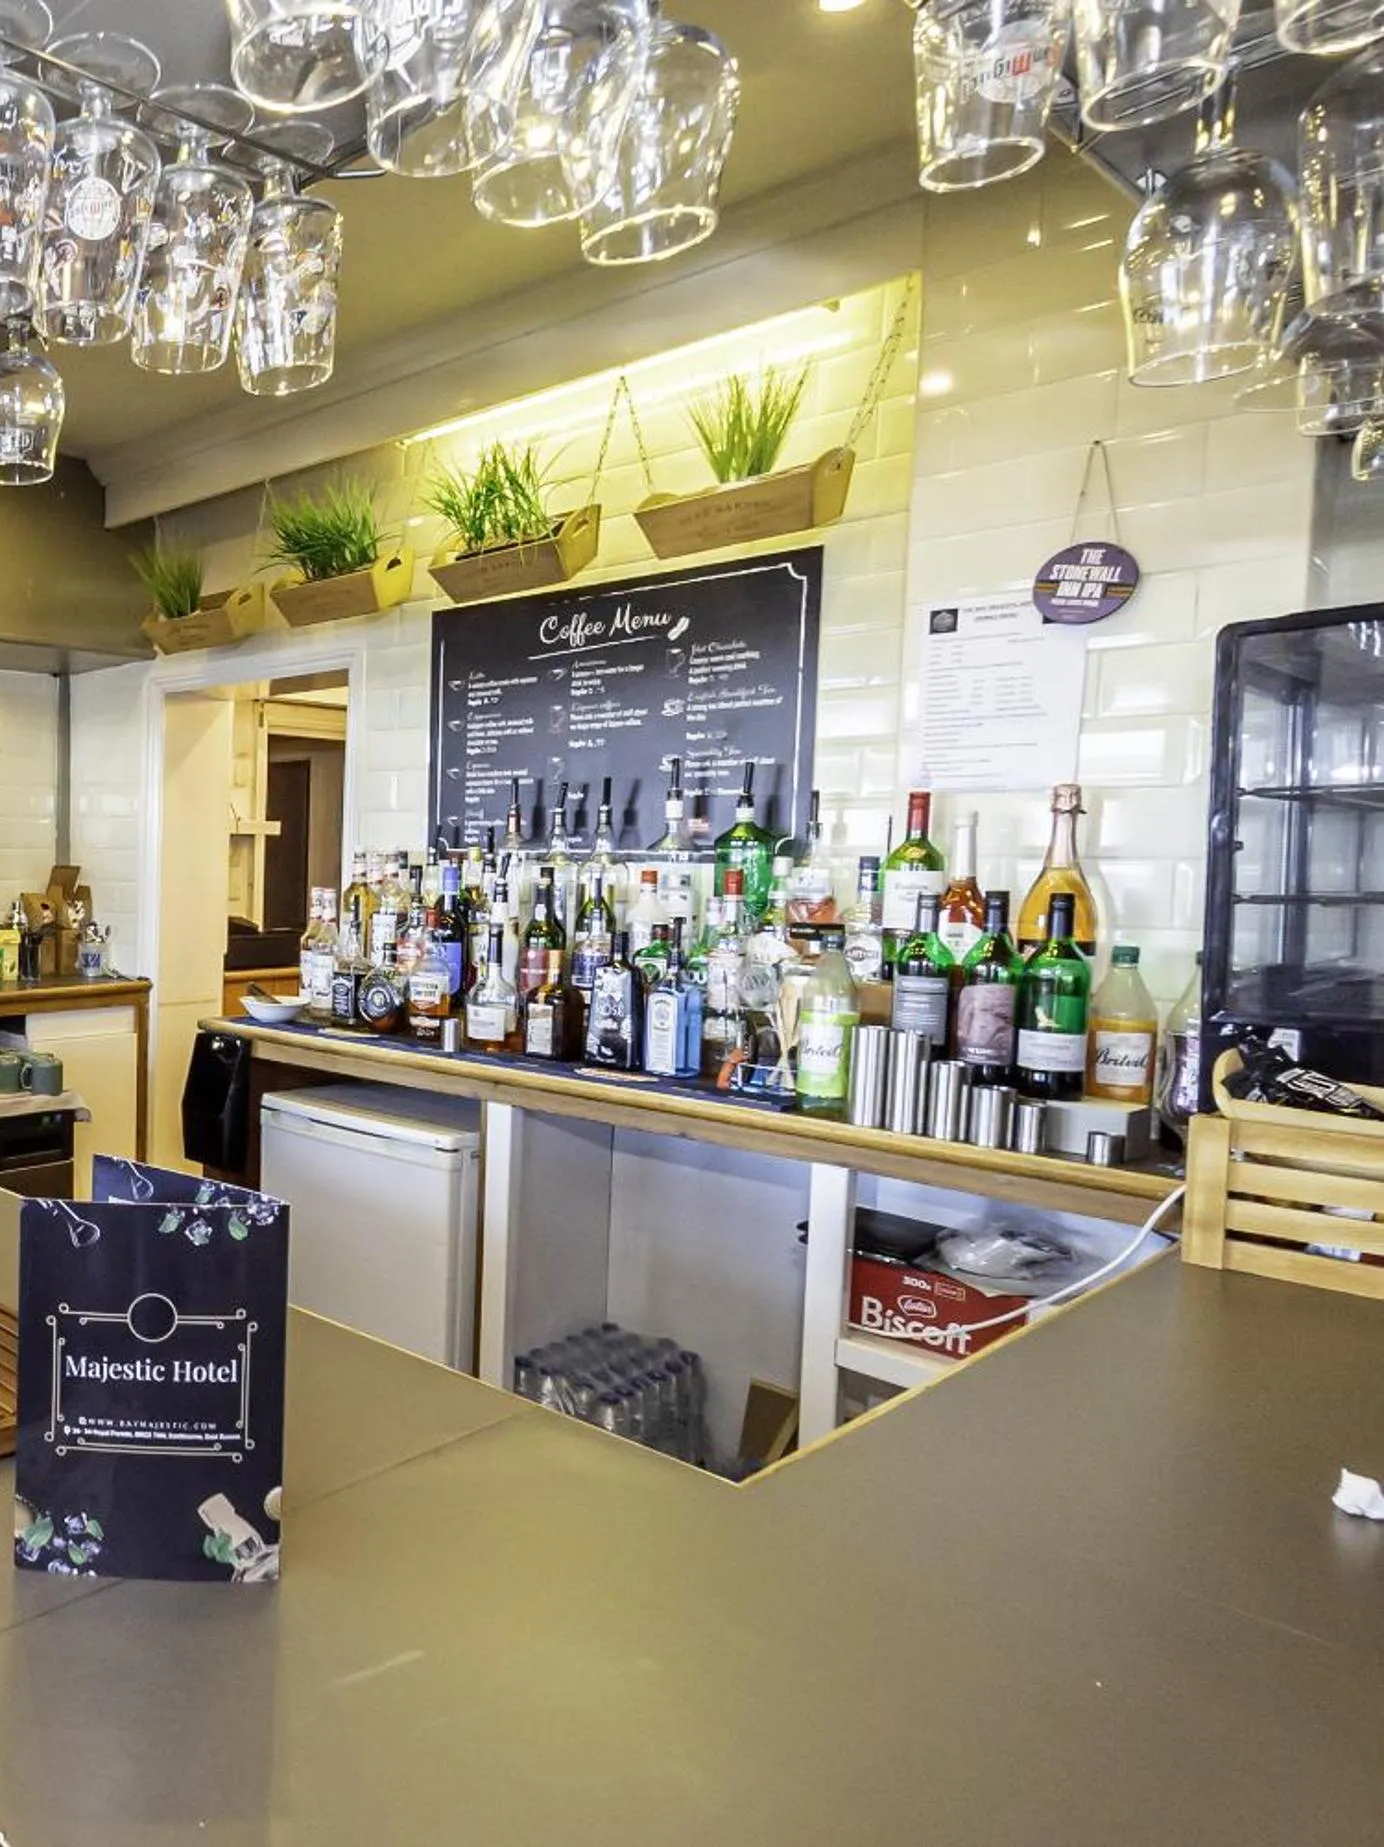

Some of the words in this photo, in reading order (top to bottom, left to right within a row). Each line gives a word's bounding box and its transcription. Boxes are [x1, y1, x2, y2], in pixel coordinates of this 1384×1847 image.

[1080, 549, 1106, 564] THE
[1049, 564, 1122, 582] STONEWALL
[1080, 582, 1104, 598] IPA
[539, 612, 605, 647] Coffee
[609, 603, 671, 638] Menu
[860, 1296, 972, 1354] Biscoff
[65, 1355, 165, 1383] Majestic
[173, 1359, 238, 1383] Hotel
